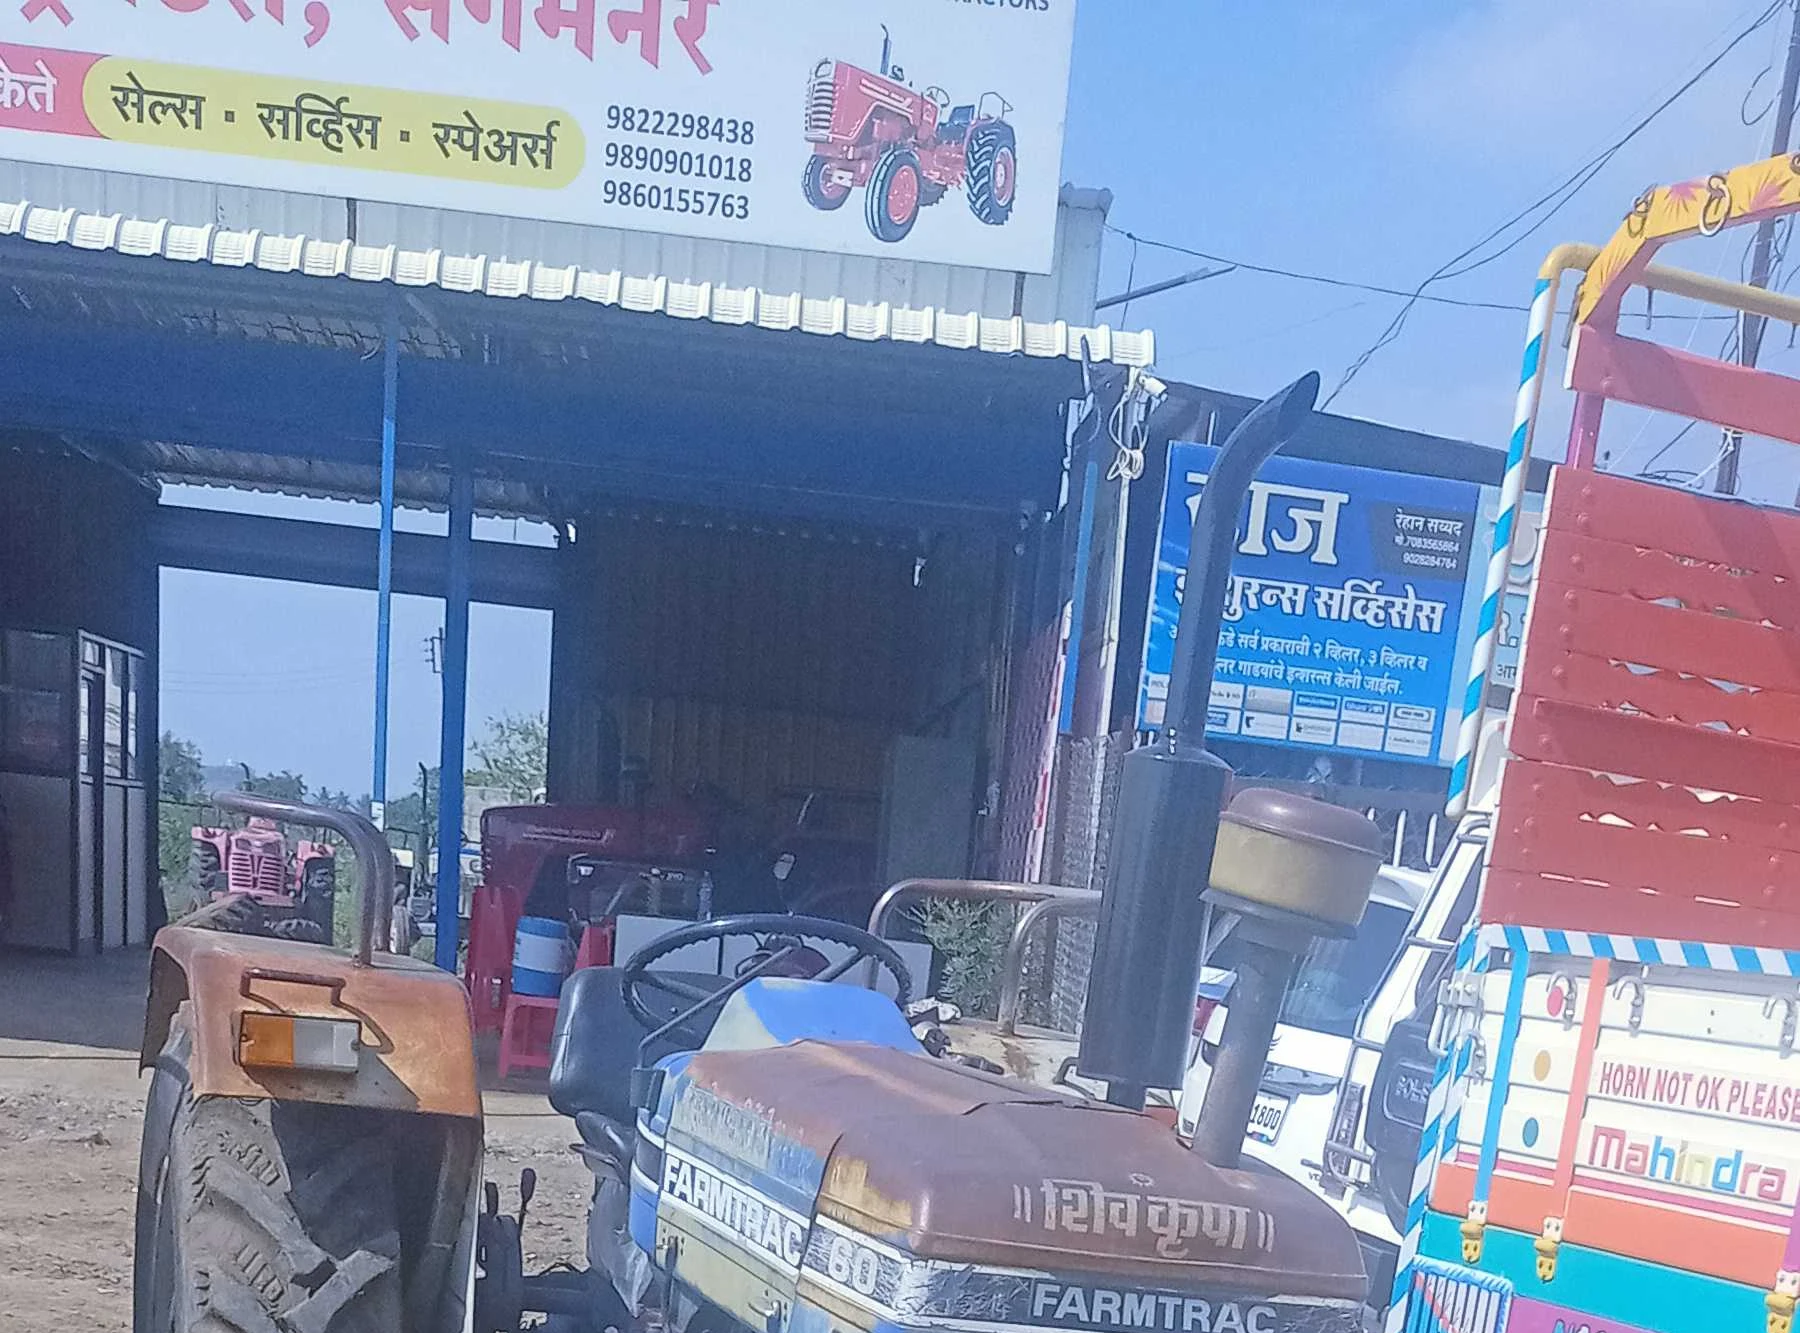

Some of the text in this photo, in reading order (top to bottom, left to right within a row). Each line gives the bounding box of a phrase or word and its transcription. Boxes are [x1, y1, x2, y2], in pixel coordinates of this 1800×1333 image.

[110, 71, 206, 130] सेल्स
[256, 92, 382, 153] सर्व्हिस
[432, 110, 560, 170] स्पेअर्स
[606, 104, 755, 146] 9822298438
[605, 142, 752, 183] 9890901018
[602, 179, 750, 220] 9860155763
[1314, 578, 1448, 634] सर्व्हिसेस
[1238, 628, 1261, 650] सर्व
[1313, 642, 1323, 659] २
[1599, 1061, 1651, 1101] HORN
[1652, 1068, 1695, 1107] NOT
[1695, 1075, 1726, 1112] OK
[1588, 1124, 1787, 1202] Mahindra
[663, 1152, 880, 1295] FARMTRAC 60
